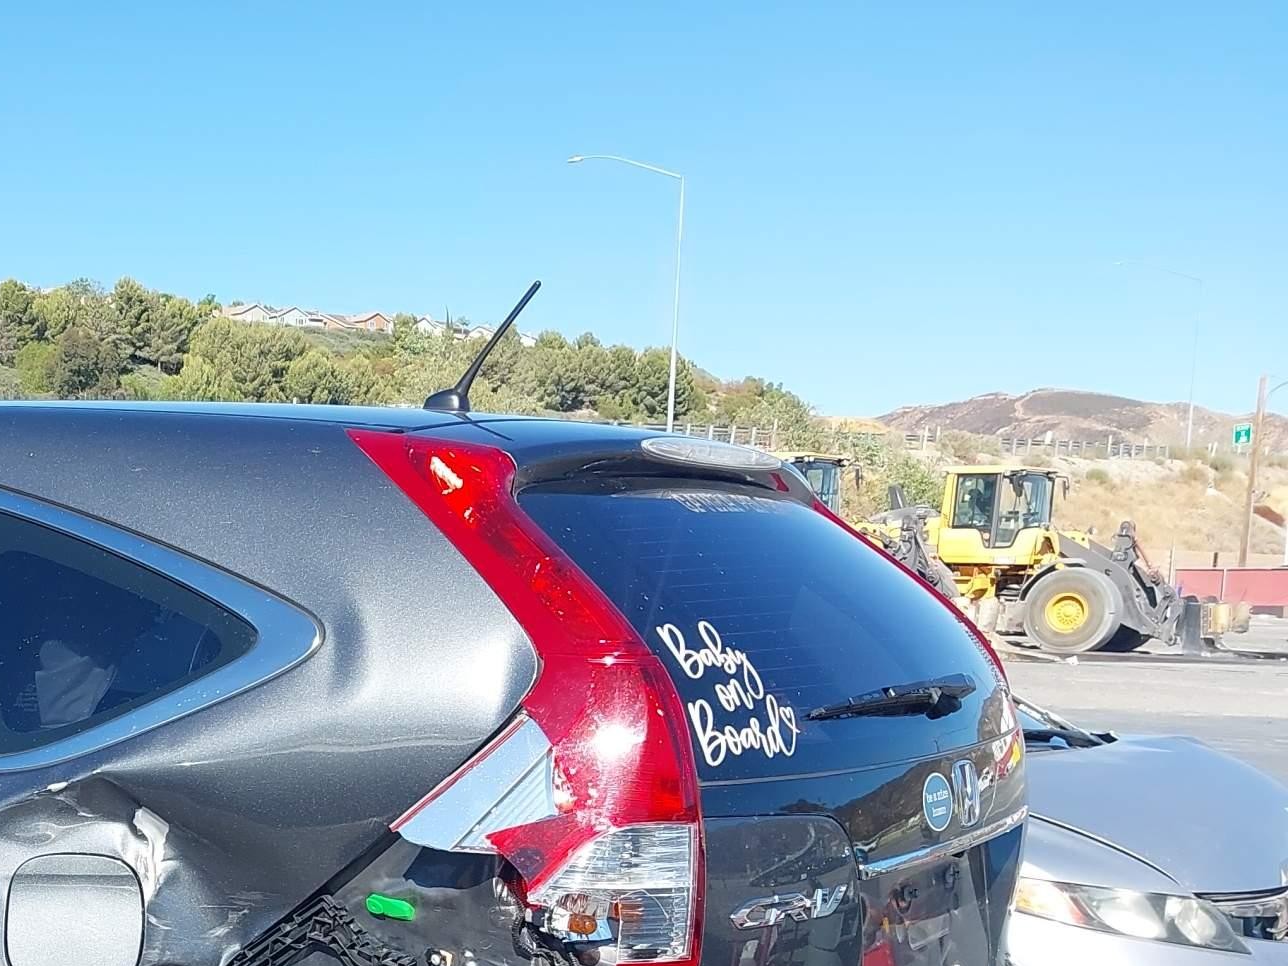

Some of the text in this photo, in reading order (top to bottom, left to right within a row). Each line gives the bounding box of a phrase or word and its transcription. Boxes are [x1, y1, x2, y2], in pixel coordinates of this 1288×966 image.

[656, 620, 764, 700] Baby
[714, 678, 754, 712] on
[687, 694, 797, 767] Board
